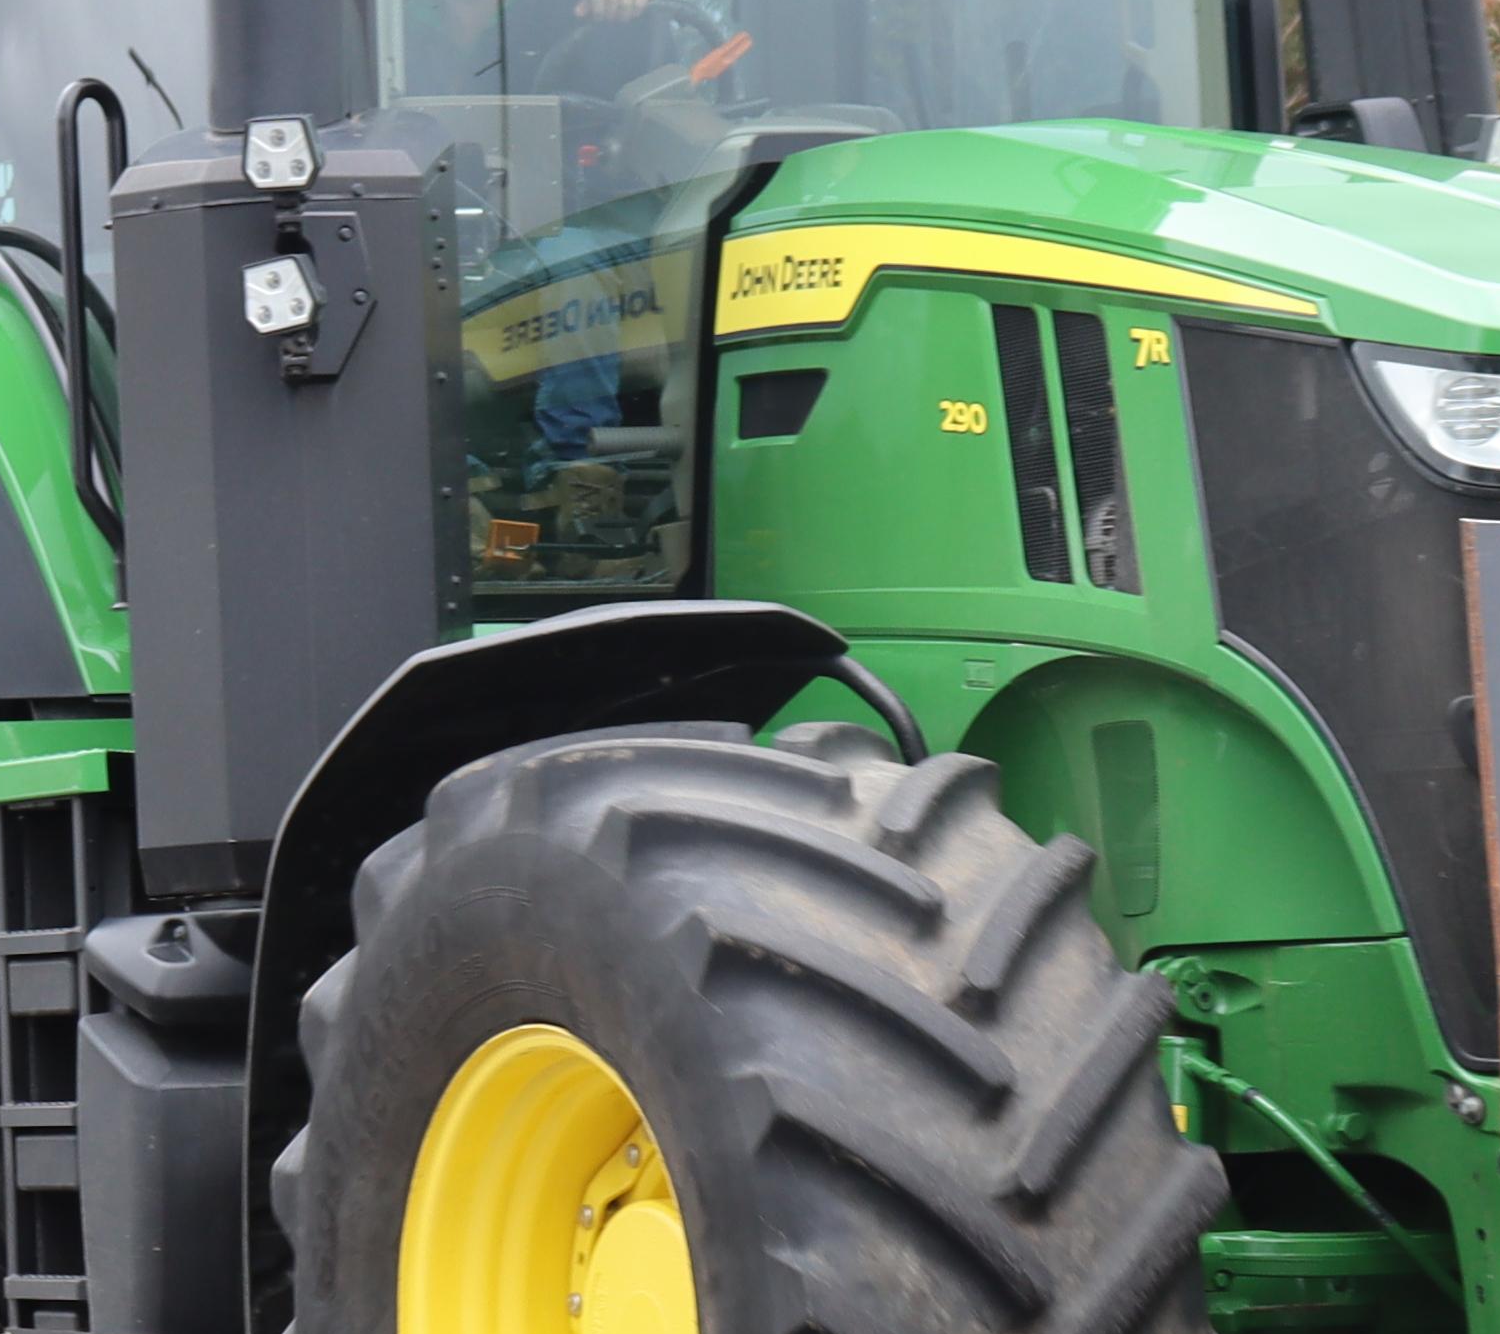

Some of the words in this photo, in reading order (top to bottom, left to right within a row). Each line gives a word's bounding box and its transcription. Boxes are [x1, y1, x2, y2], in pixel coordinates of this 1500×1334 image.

[730, 263, 778, 299] JOHN
[781, 255, 844, 290] DEERE
[1129, 327, 1171, 368] 7R
[939, 400, 988, 435] 290
